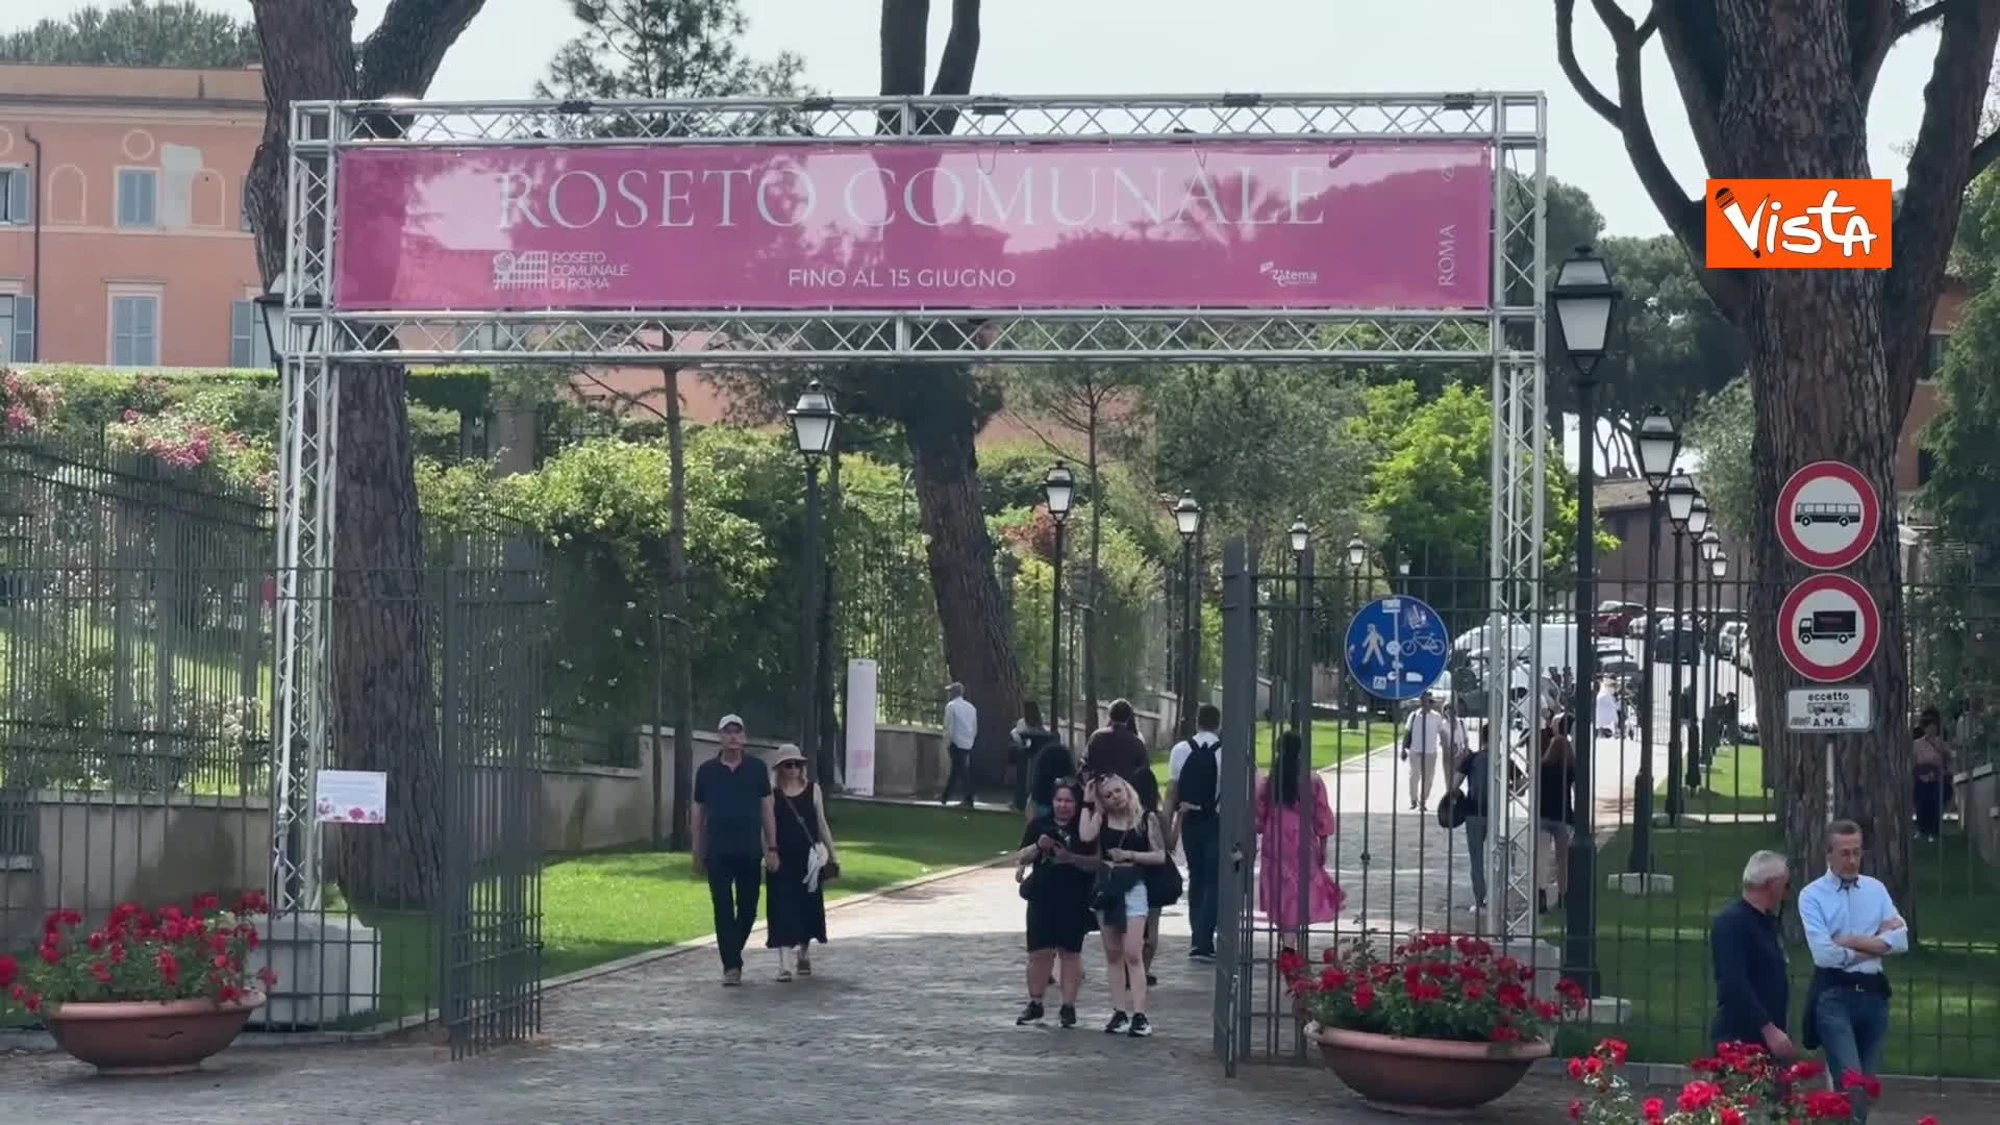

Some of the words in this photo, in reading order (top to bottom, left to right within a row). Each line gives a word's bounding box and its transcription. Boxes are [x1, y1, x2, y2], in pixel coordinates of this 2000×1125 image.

[497, 169, 817, 228] ROSETO
[843, 166, 1326, 226] COMUNALE
[552, 252, 606, 264] ROSETO
[1438, 224, 1457, 286] ROMA
[551, 264, 630, 276] COMUNALE
[552, 278, 566, 290] DI
[568, 278, 609, 290] ROMA
[788, 268, 847, 288] FINO
[852, 268, 884, 288] AL
[889, 268, 911, 288] 15
[917, 268, 1017, 288] GIUGNO
[1808, 692, 1849, 701] eccetto
